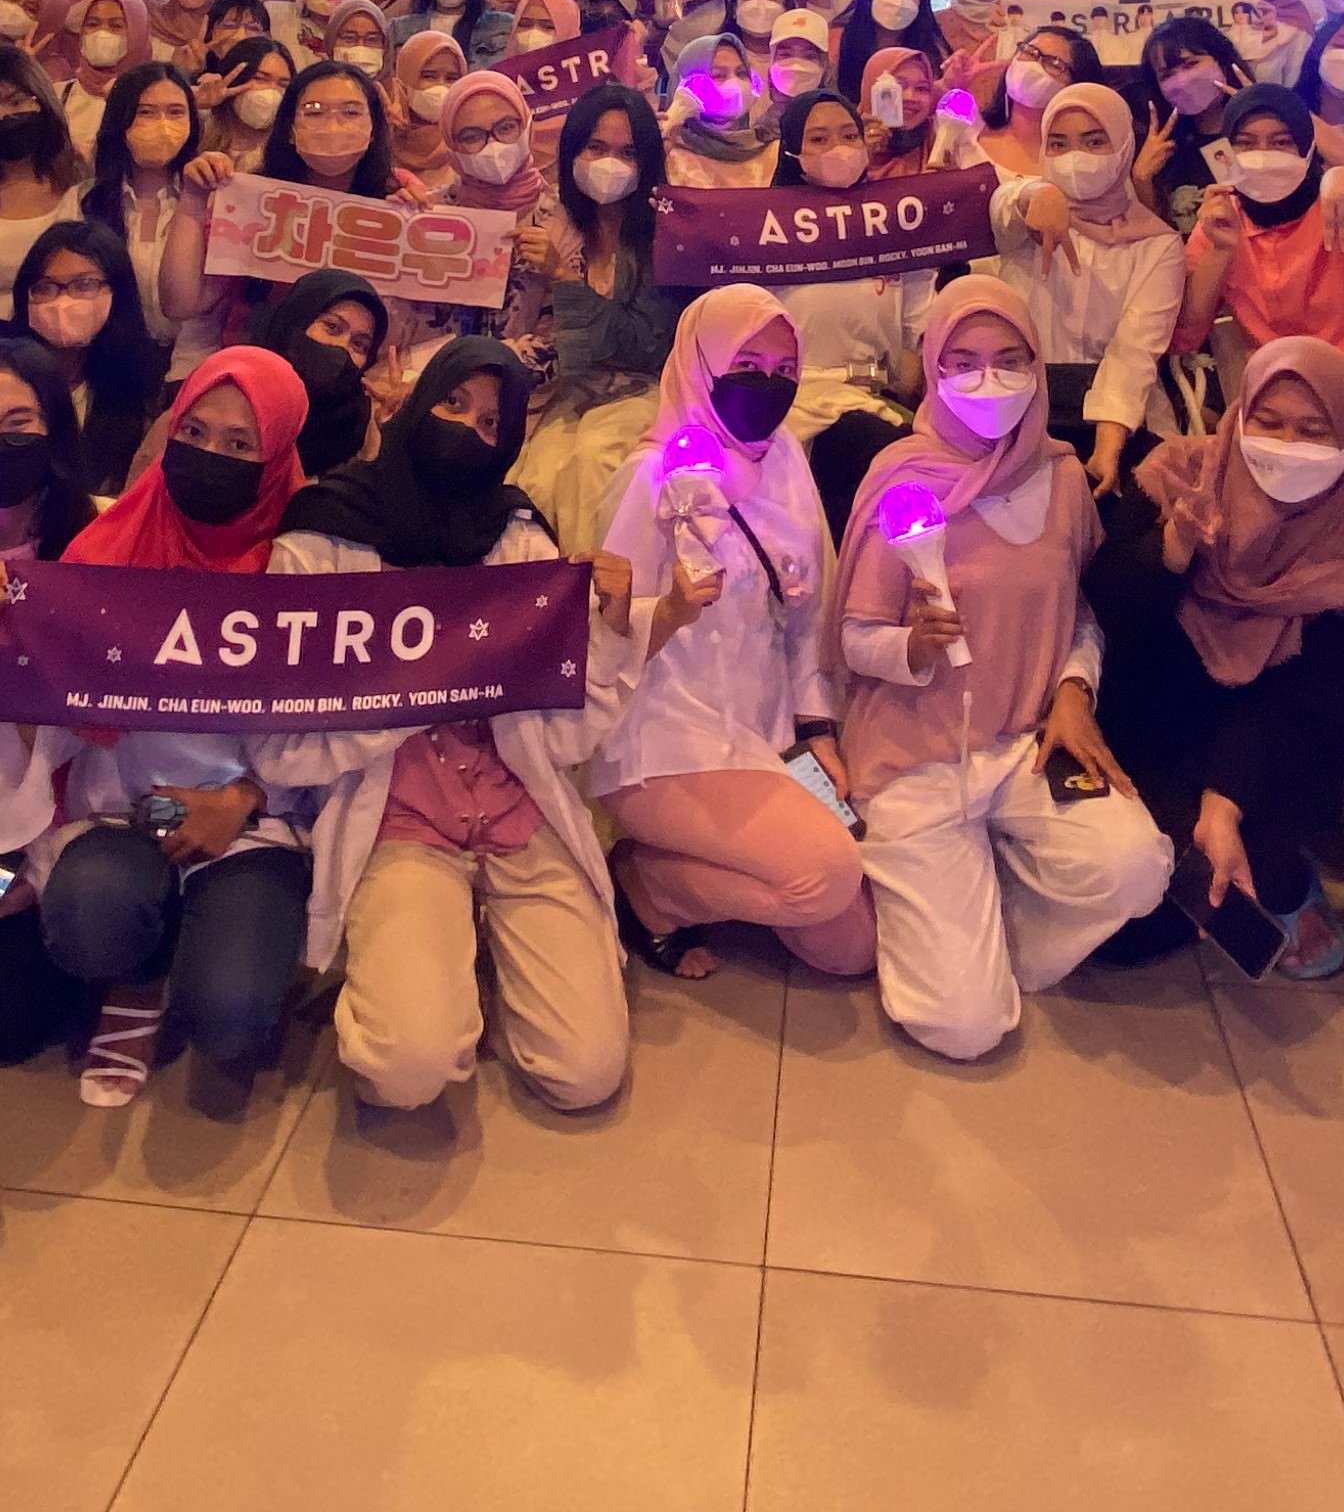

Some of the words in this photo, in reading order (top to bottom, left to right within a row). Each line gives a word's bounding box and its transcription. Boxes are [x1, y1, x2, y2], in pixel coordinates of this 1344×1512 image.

[516, 49, 610, 96] ASTR
[254, 190, 475, 284] 차은우
[758, 196, 924, 246] ASTRO
[154, 605, 436, 666] ASTRO
[158, 697, 188, 713] CHA
[271, 698, 315, 713] MOON
[352, 692, 403, 711] ROCKY.
[409, 689, 447, 707] YOON
[449, 683, 504, 702] SAN-HA
